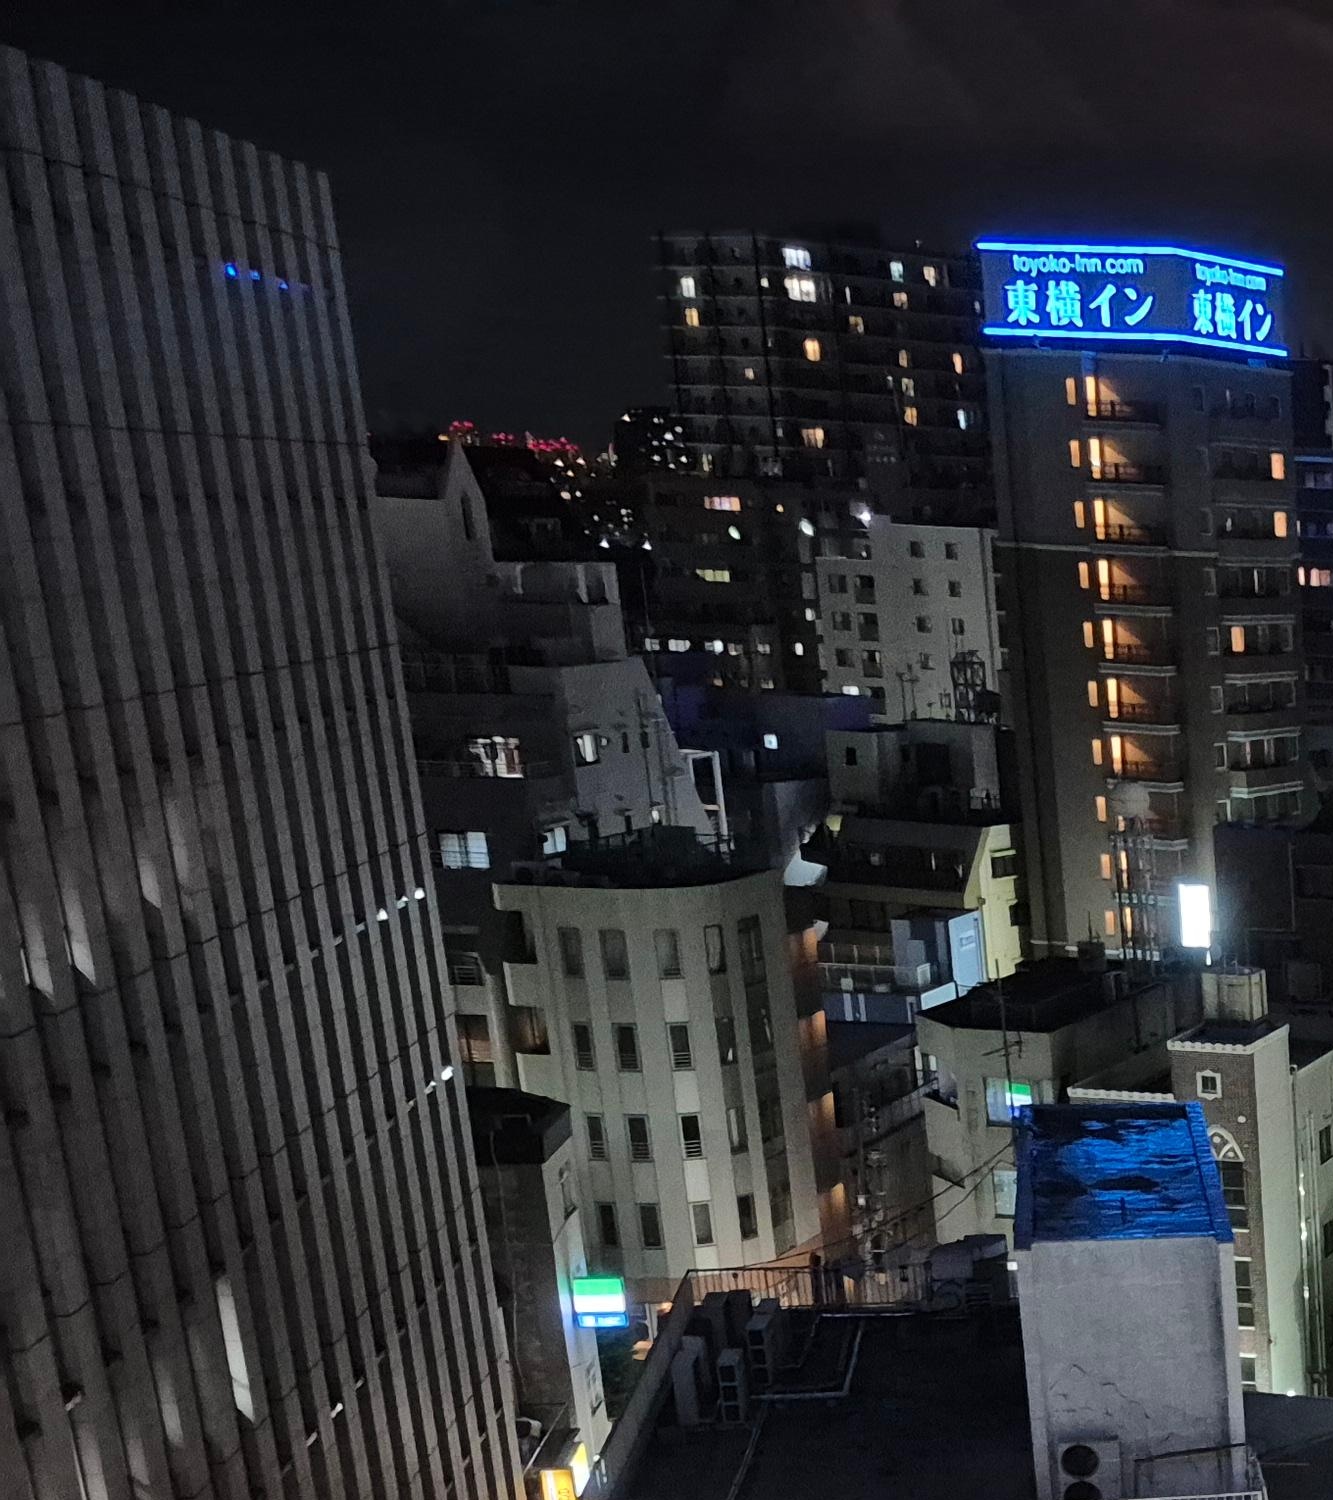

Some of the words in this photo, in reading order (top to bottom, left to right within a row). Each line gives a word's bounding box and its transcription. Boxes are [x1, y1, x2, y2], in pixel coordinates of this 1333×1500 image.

[1006, 280, 1153, 326] 東横イン
[1192, 289, 1272, 341] 東横イン
